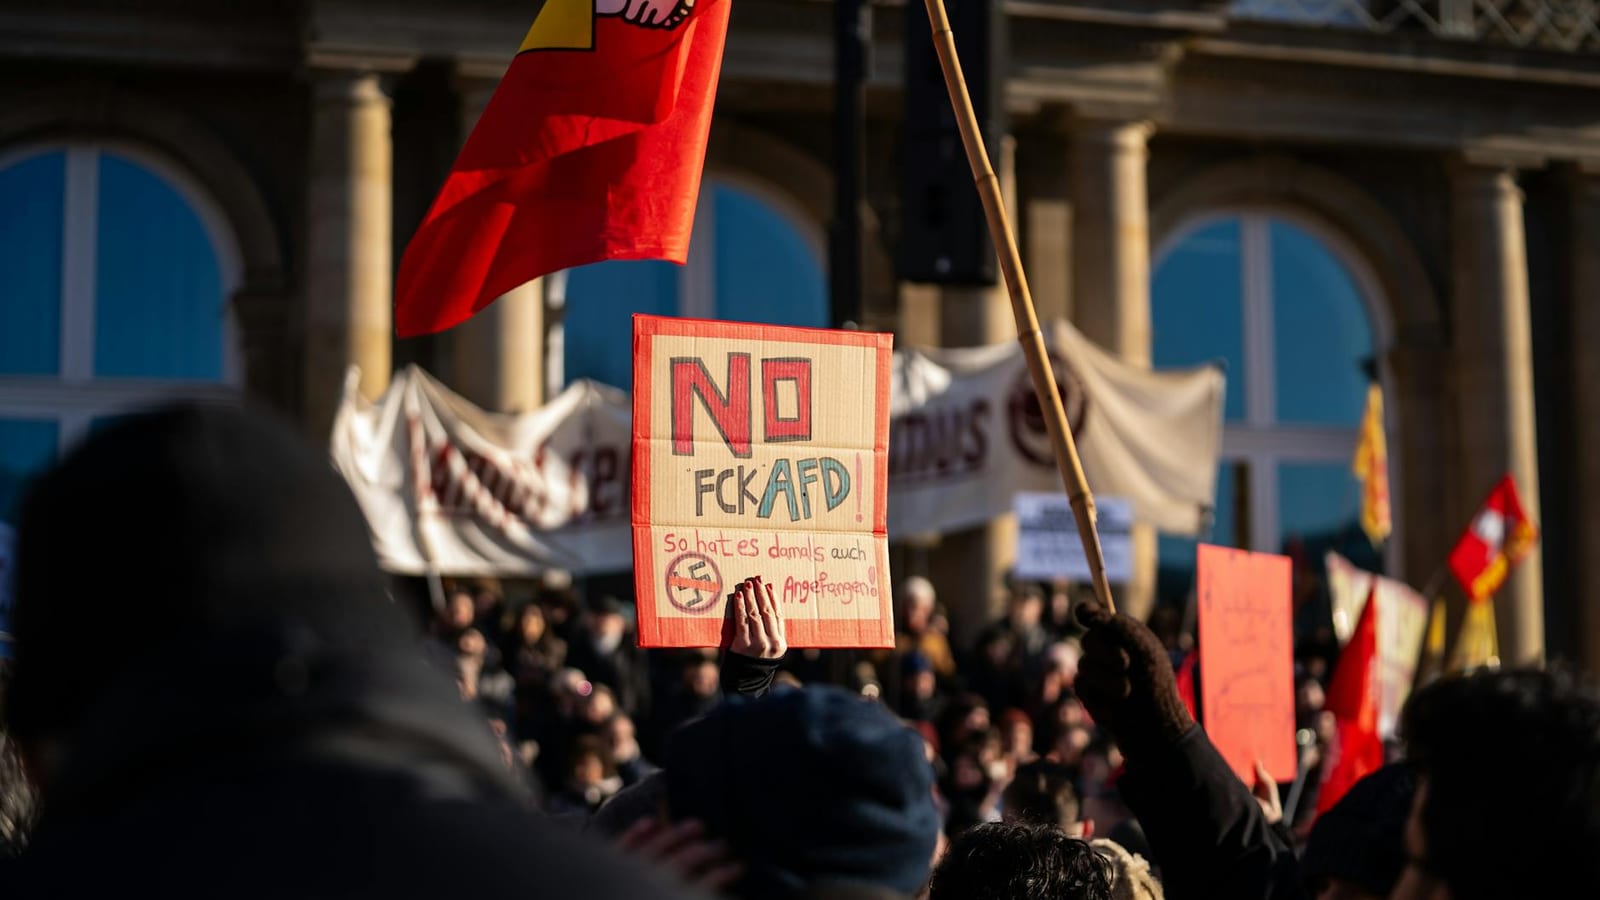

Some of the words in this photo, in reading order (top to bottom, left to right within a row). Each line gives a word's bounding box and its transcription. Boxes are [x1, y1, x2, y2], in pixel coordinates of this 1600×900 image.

[670, 352, 812, 459] NO
[664, 533, 688, 553] So
[695, 529, 734, 557] hat
[737, 538, 760, 557] es
[768, 533, 825, 562] damals
[831, 539, 867, 561] auch
[783, 566, 878, 605] Angefangen!
